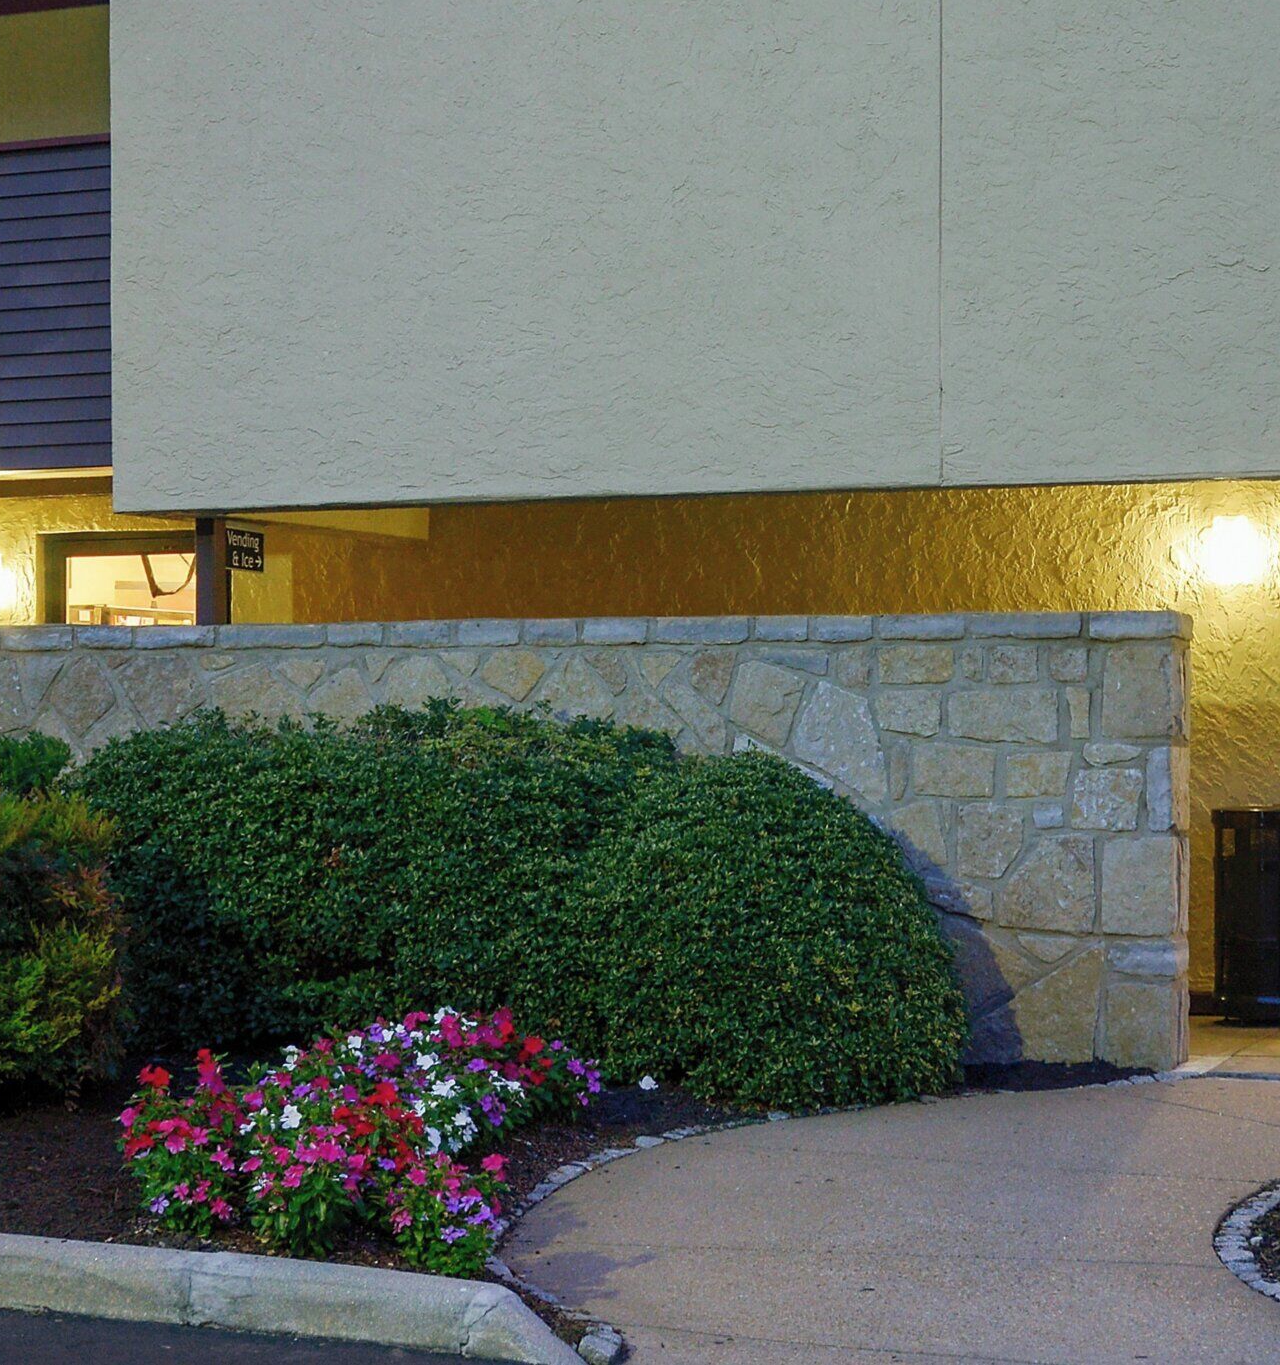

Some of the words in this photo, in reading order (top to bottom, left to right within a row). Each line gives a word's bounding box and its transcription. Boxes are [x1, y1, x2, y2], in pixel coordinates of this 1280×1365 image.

[227, 530, 260, 553] Vending
[232, 550, 239, 566] &
[241, 552, 254, 568] Ice
